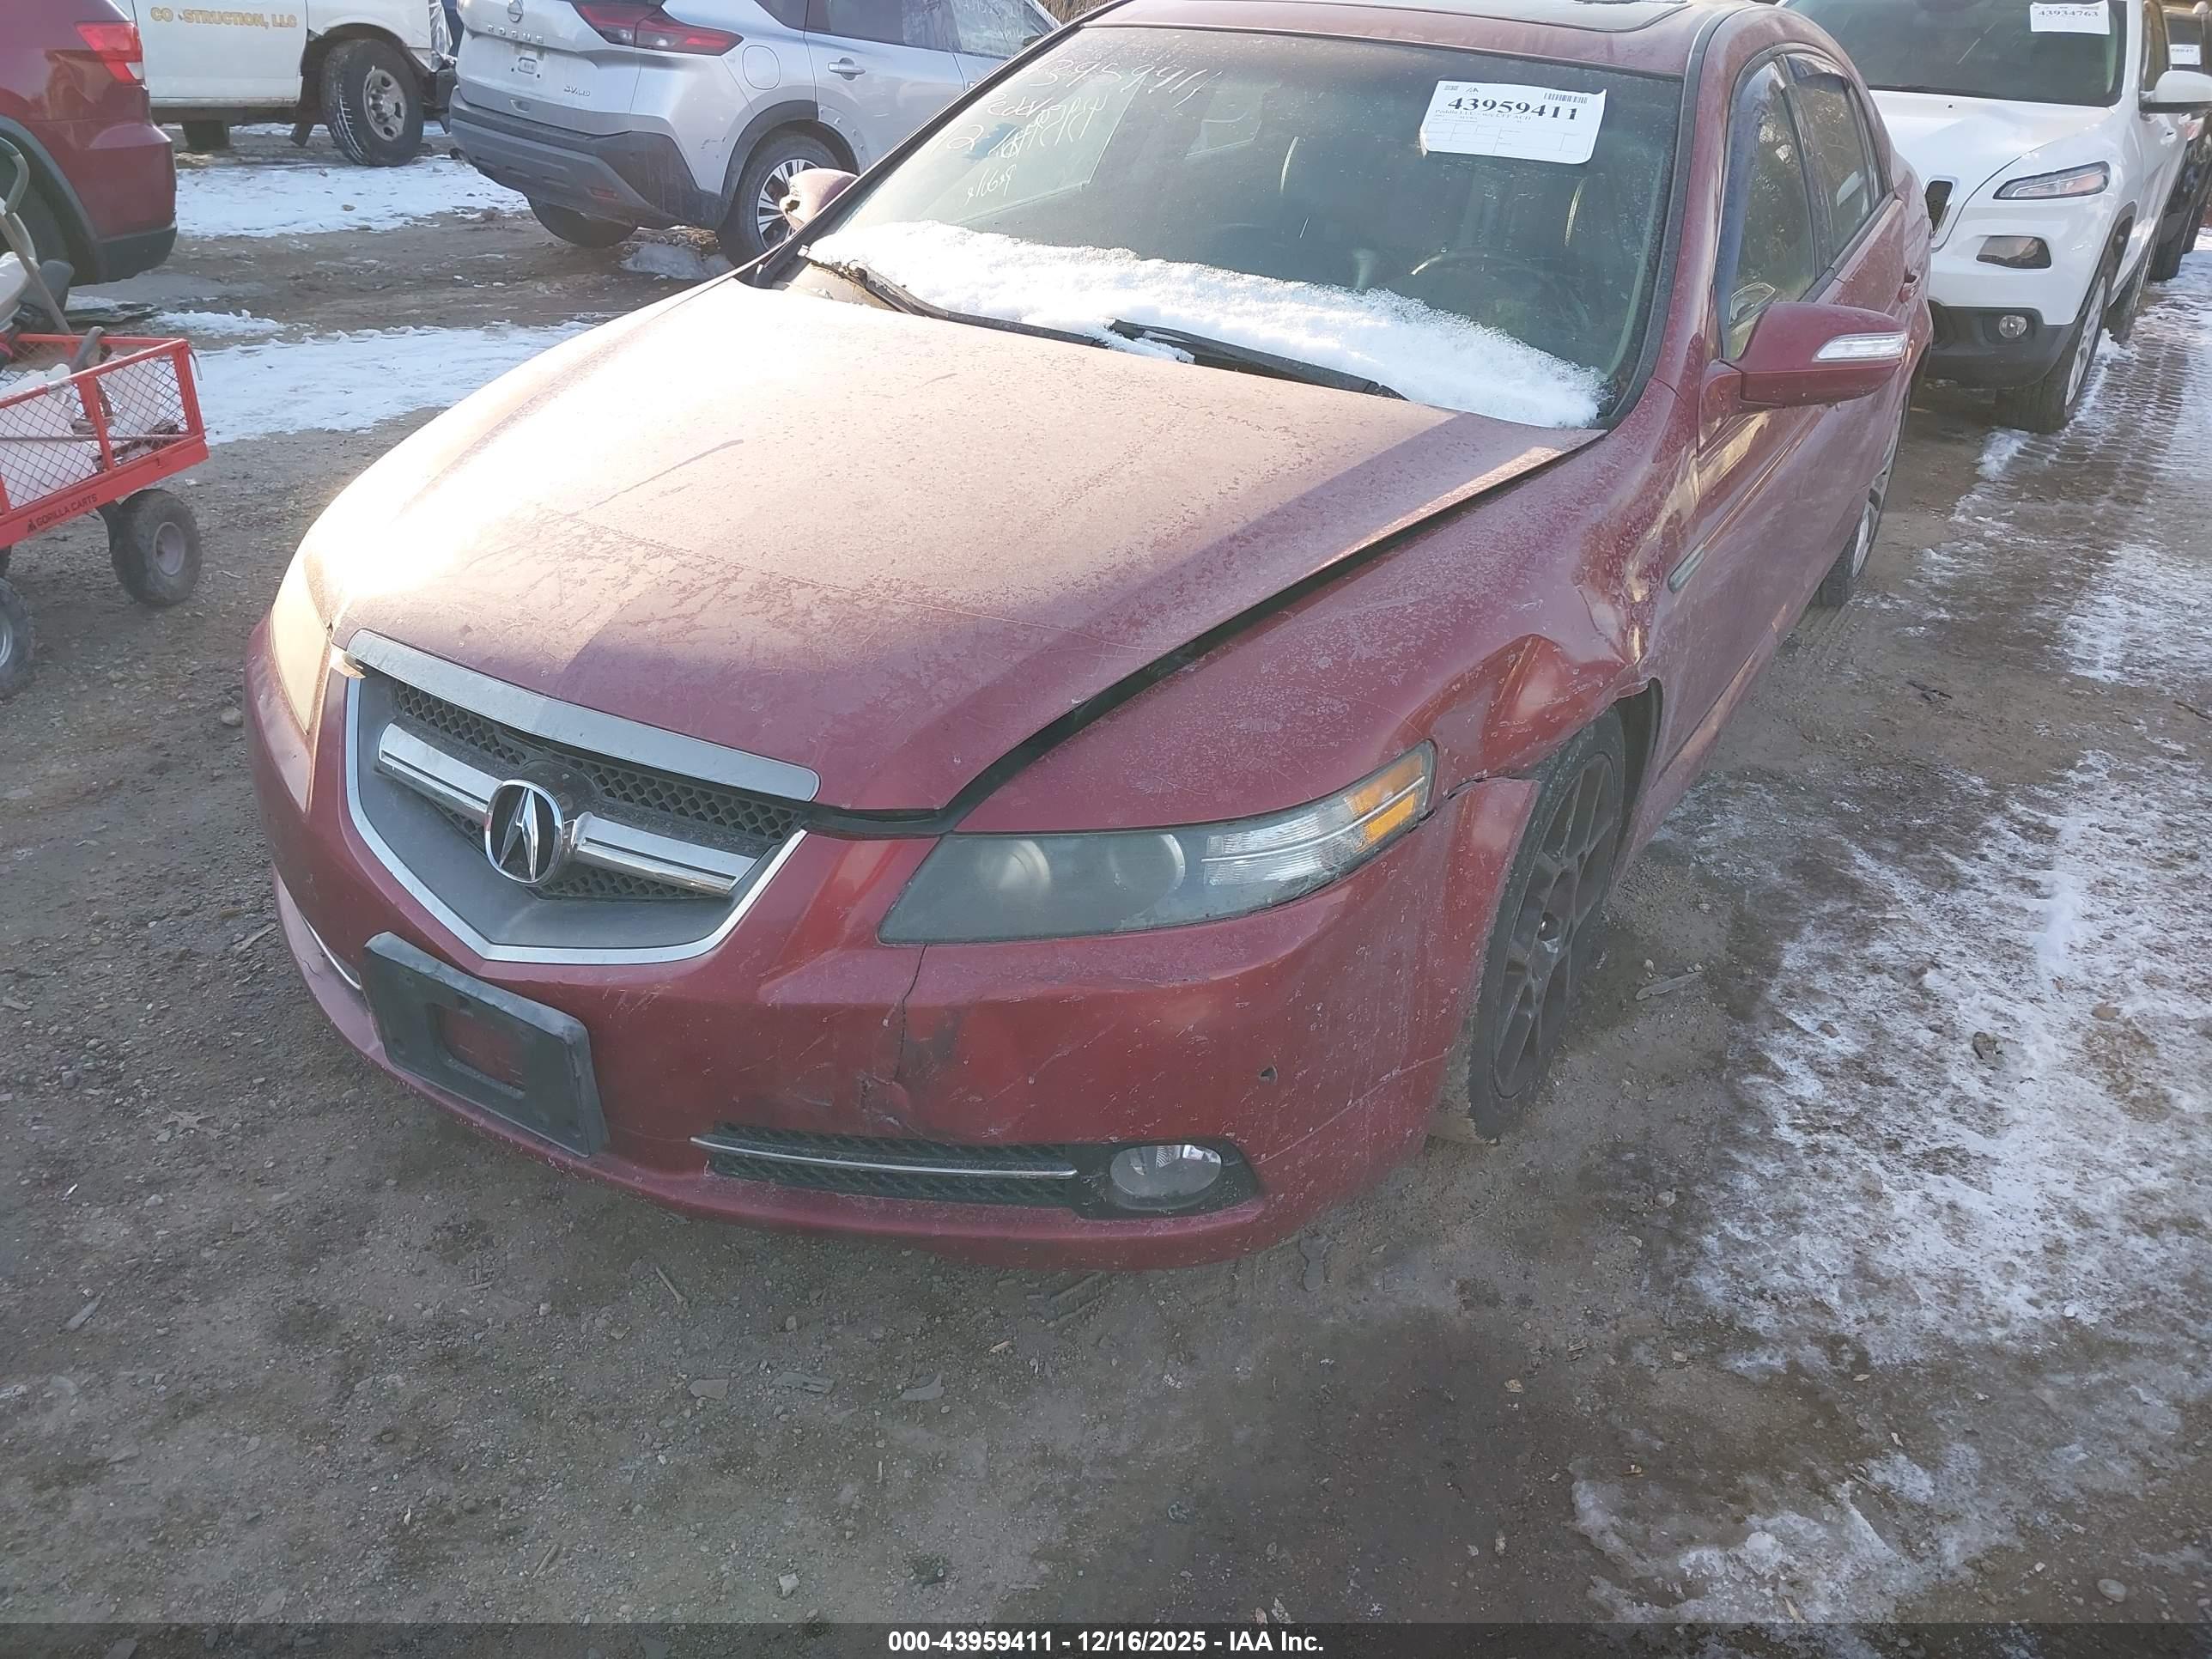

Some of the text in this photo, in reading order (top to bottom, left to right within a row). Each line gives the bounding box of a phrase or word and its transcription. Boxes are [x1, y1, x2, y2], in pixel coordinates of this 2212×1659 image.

[150, 7, 297, 29] COSTRUCTION, LLC
[1448, 97, 1578, 121] 43959411
[70, 493, 98, 511] CARTS
